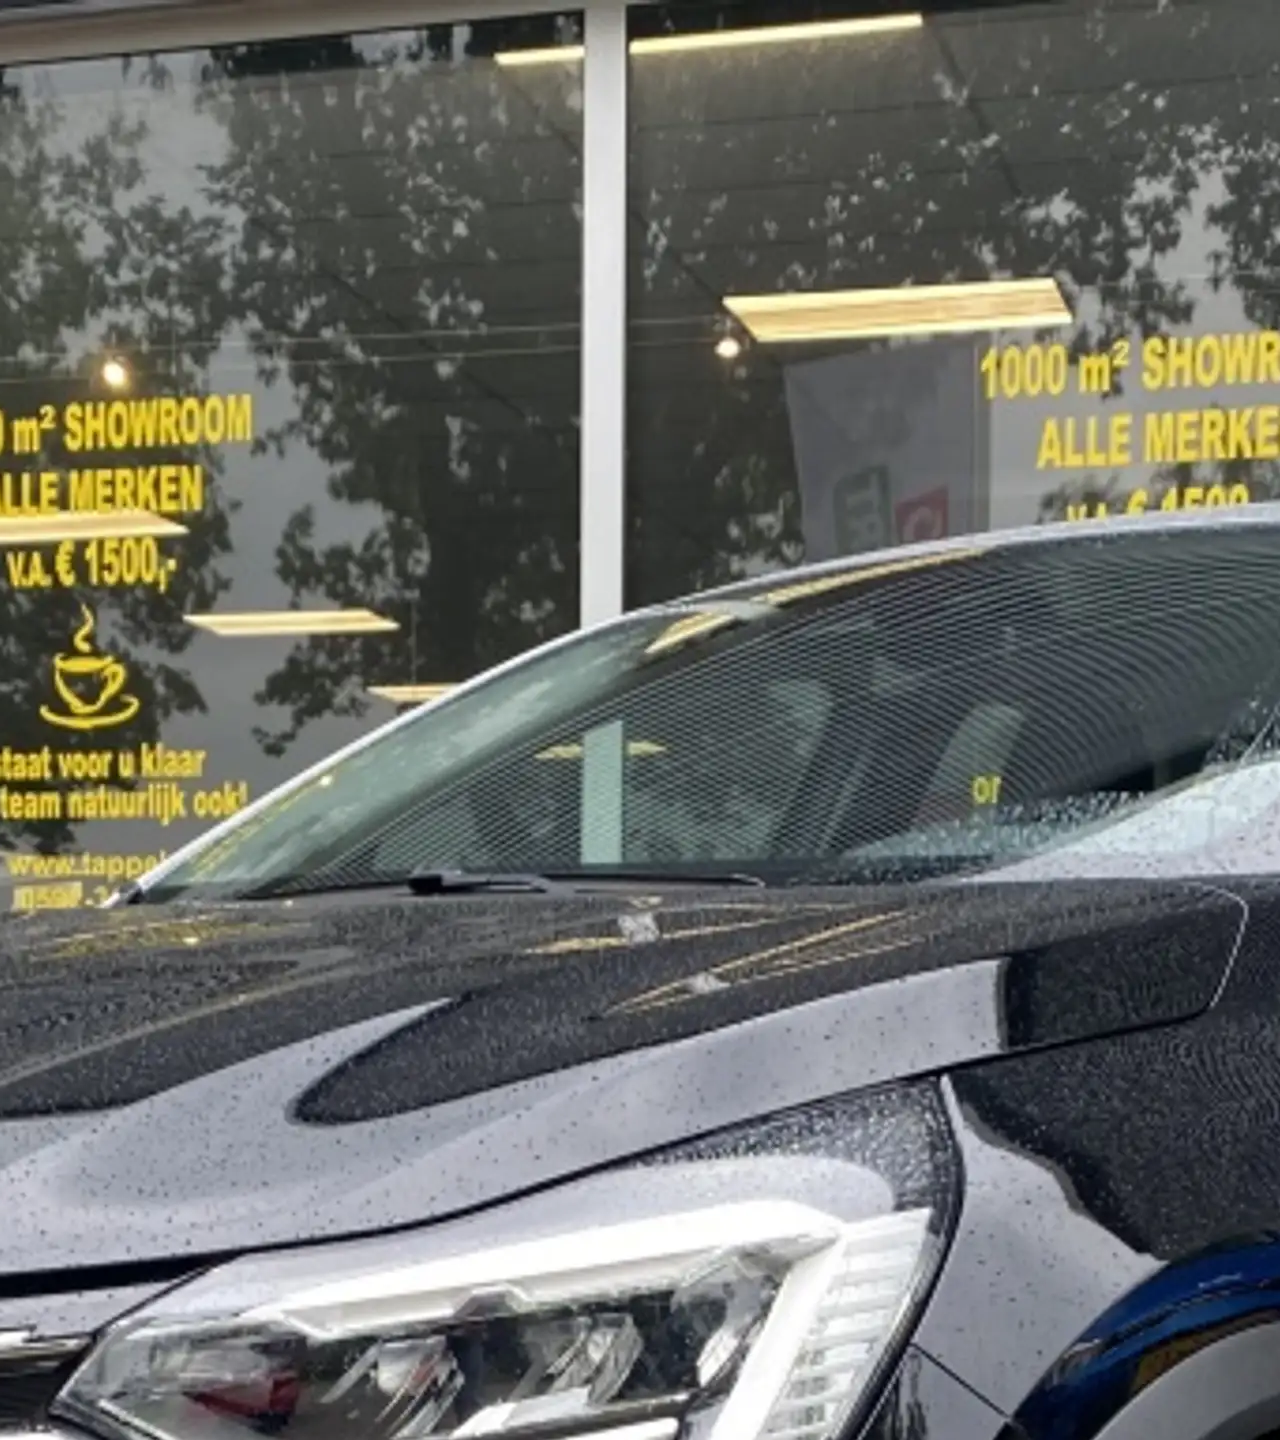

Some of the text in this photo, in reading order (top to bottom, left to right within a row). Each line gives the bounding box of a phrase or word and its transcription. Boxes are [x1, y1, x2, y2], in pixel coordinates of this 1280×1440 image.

[980, 343, 1067, 398] 1000
[63, 394, 252, 452] SHOWROOM
[1036, 414, 1131, 469] ALLE
[68, 465, 204, 514] MERKEN
[6, 551, 51, 588] V.A.
[54, 540, 76, 587] €
[57, 750, 113, 780] voor
[118, 753, 134, 780] u
[140, 743, 205, 779] klaar
[66, 785, 187, 826] natuurlijk
[193, 781, 249, 817] ook!
